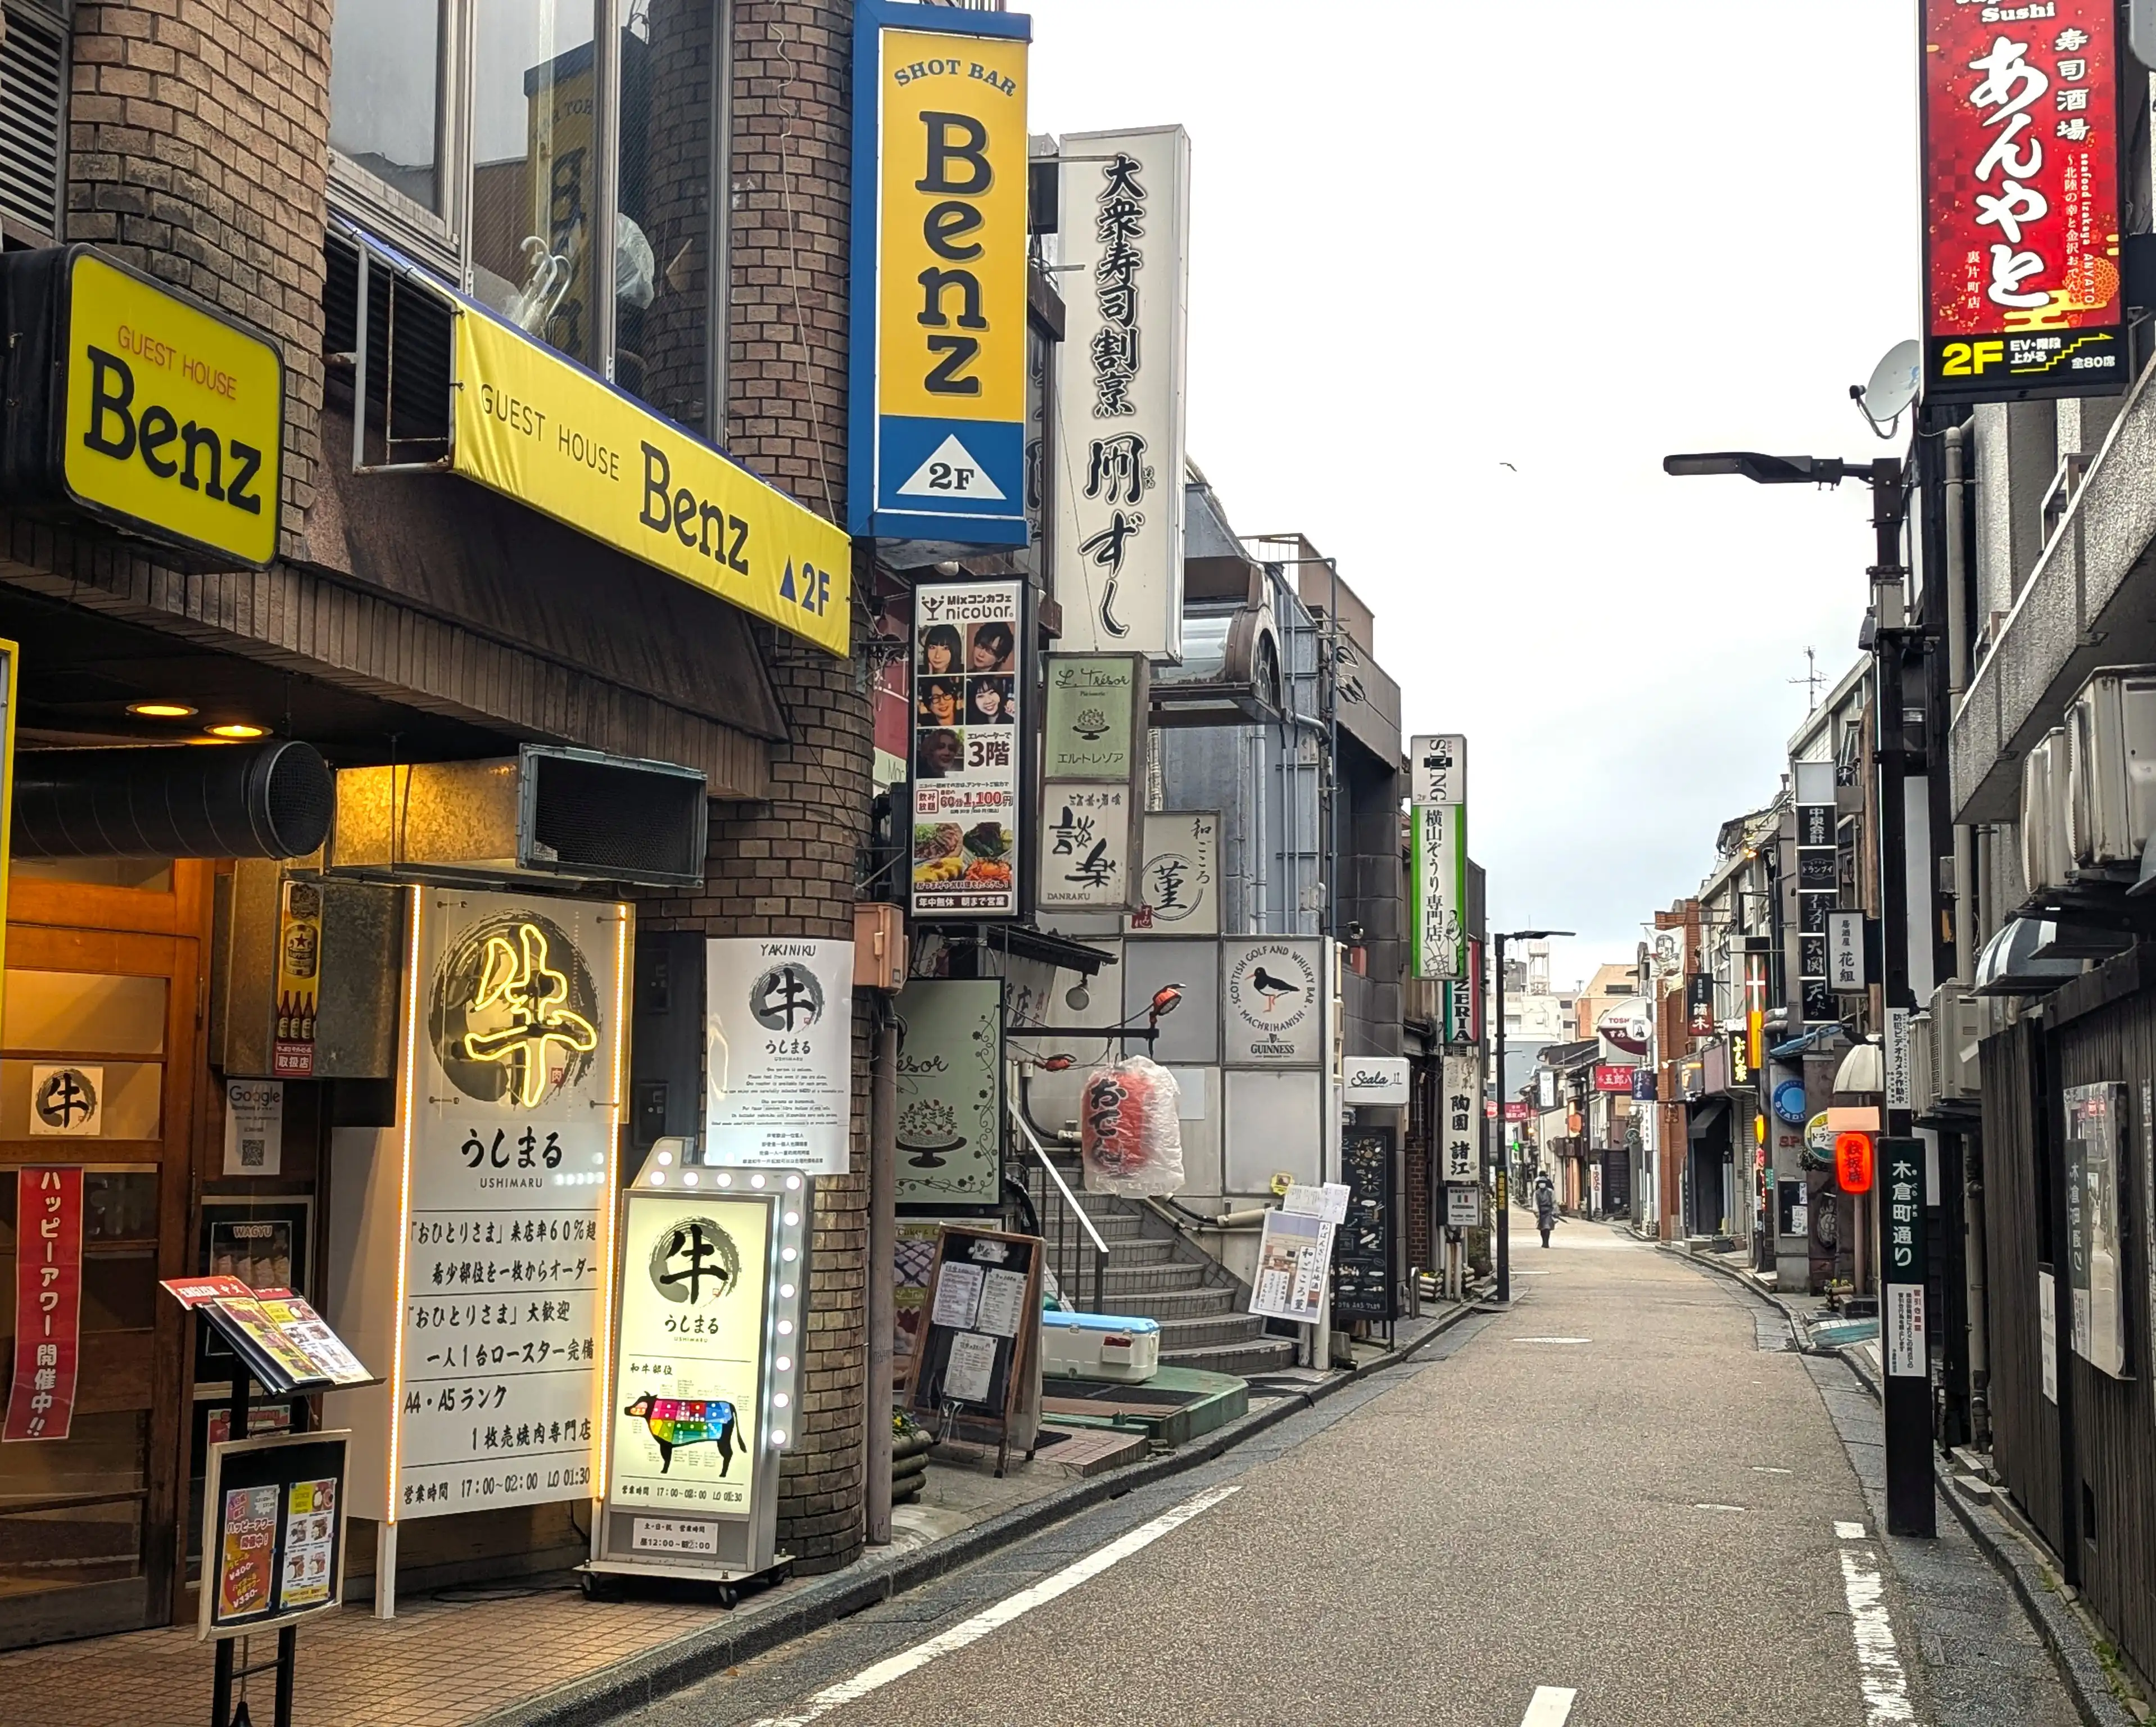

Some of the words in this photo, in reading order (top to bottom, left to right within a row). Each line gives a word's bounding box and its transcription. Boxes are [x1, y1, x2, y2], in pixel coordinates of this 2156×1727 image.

[1981, 2, 2055, 22] Sushi
[894, 58, 961, 88] SHOT
[970, 62, 1017, 97] BAR
[2055, 29, 2090, 141] 寿司酒場
[1969, 37, 2050, 308] あんやと
[915, 110, 995, 397] Benz
[1092, 153, 1147, 418] 大衆寿司割烹
[1968, 251, 1980, 309] 裏片町店
[2083, 254, 2095, 303] ANYATO
[118, 325, 176, 370] GUEST
[183, 355, 237, 401] HOUSE
[1942, 341, 2004, 376] 2F
[2010, 351, 2047, 364] 上がる
[2072, 356, 2115, 369] 全80席
[84, 345, 261, 515] Benz
[928, 462, 975, 491] 2F
[481, 383, 546, 442] GUEST
[559, 423, 619, 481] HOUSE
[640, 440, 749, 576] Benz
[801, 563, 830, 617] 2F
[947, 594, 1012, 605] Mixコンカフェ
[968, 741, 1010, 767] 3階
[1430, 739, 1446, 802] STING
[1191, 818, 1212, 884] 和ごころ
[1425, 810, 1443, 942] 横山ぞうり専門店
[919, 897, 954, 907] 年中無休
[1047, 892, 1090, 901] DANRAKU
[761, 944, 816, 956] YAKINIKU
[1230, 960, 1248, 1005] SCOTTISH
[1245, 946, 1267, 962] GOLF
[1270, 944, 1289, 955] AND
[1291, 952, 1315, 986] WHISKY
[1306, 987, 1315, 1005] BAR
[1838, 952, 1855, 982] 花組
[759, 963, 816, 1032] 牛
[1240, 1010, 1305, 1032] MACHRIHANISH
[766, 1038, 811, 1055] うしまる
[1250, 1043, 1295, 1055] GUINNESS
[279, 1055, 309, 1069] 取扱店
[1351, 1070, 1389, 1086] Scala
[43, 1073, 89, 1128] 牛
[229, 1086, 280, 1106] Google
[461, 1126, 563, 1169] うしまる
[480, 1178, 543, 1188] USHIMARU
[1892, 1160, 1912, 1266] 木倉町通り
[233, 1226, 273, 1238] WAGYU
[660, 1224, 728, 1305] 牛
[177, 1286, 220, 1298] ENGLISH
[664, 1314, 719, 1335] うしまる
[630, 1363, 673, 1376] 和牛部位
[404, 1481, 449, 1506] 営業時間
[547, 1471, 560, 1489] LO
[564, 1467, 591, 1488] 01:30
[622, 1485, 650, 1496] 営業時間
[679, 1524, 705, 1534] 営業時間
